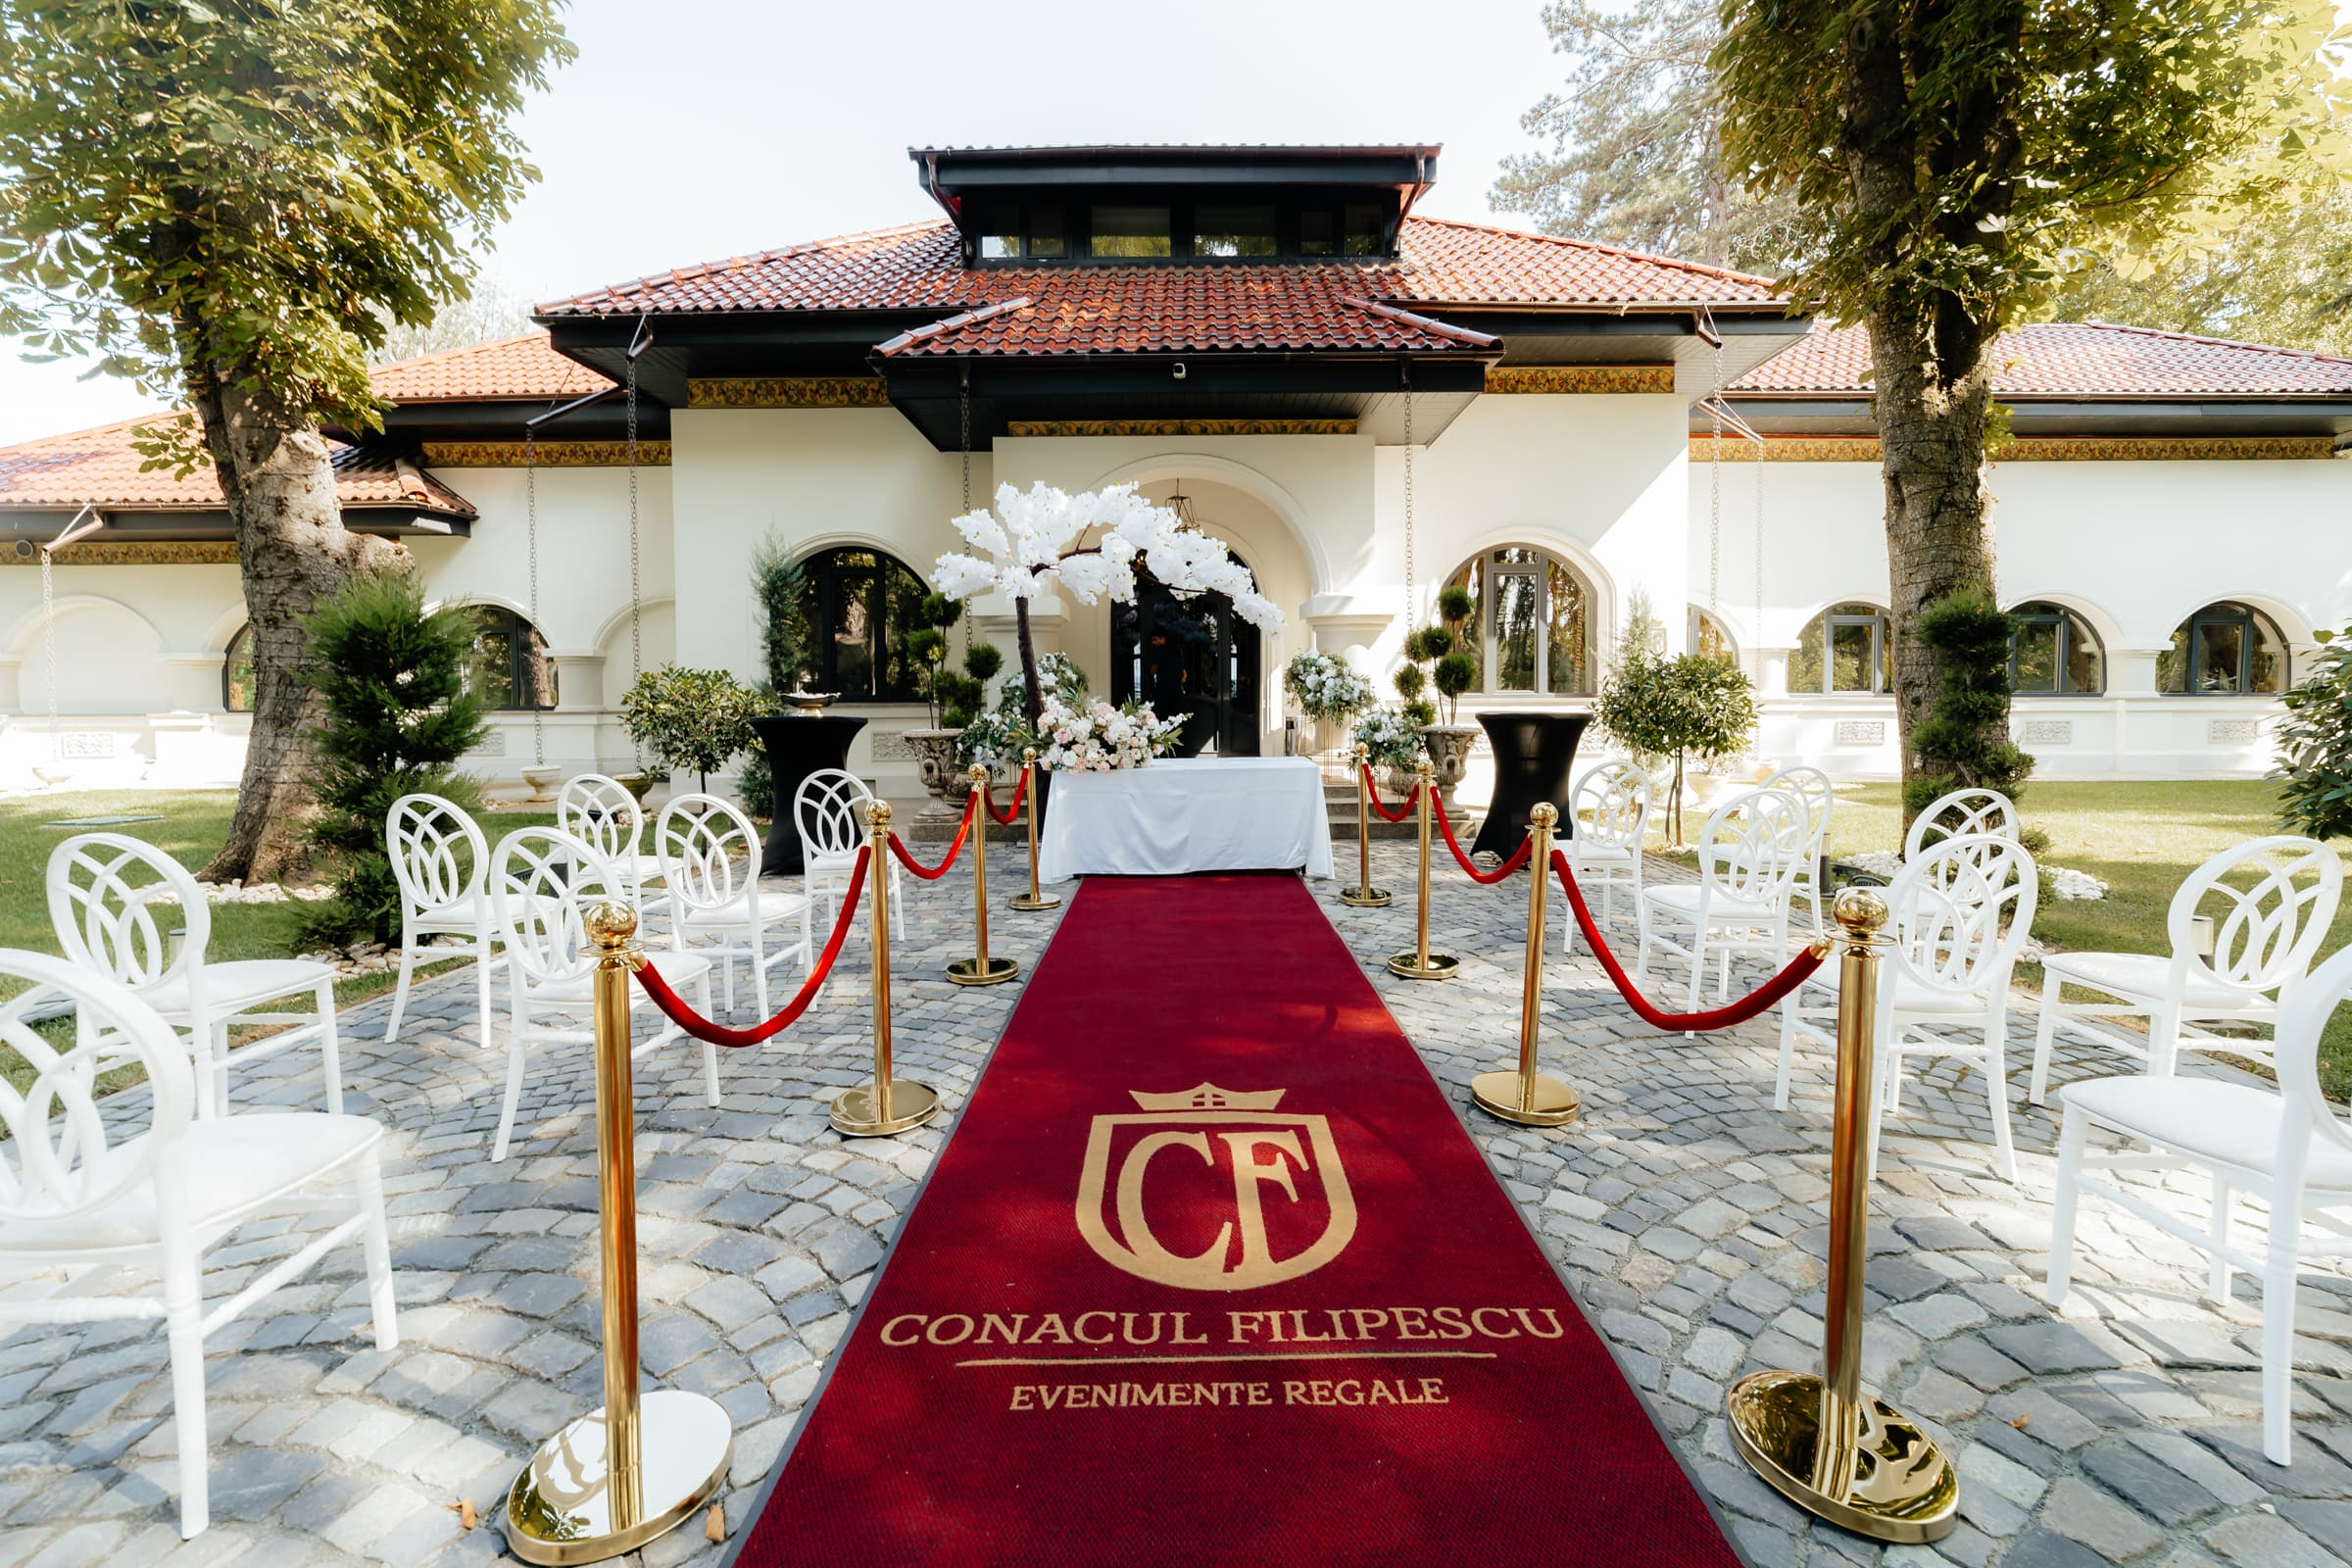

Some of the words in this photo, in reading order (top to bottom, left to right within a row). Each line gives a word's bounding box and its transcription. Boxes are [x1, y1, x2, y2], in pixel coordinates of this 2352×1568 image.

[1116, 1129, 1310, 1275] CF
[879, 1311, 1208, 1348] CONACUL
[1226, 1305, 1565, 1343] FILIPESCU
[1008, 1381, 1273, 1411] EVENIMENTE
[1282, 1377, 1450, 1406] REGALE
